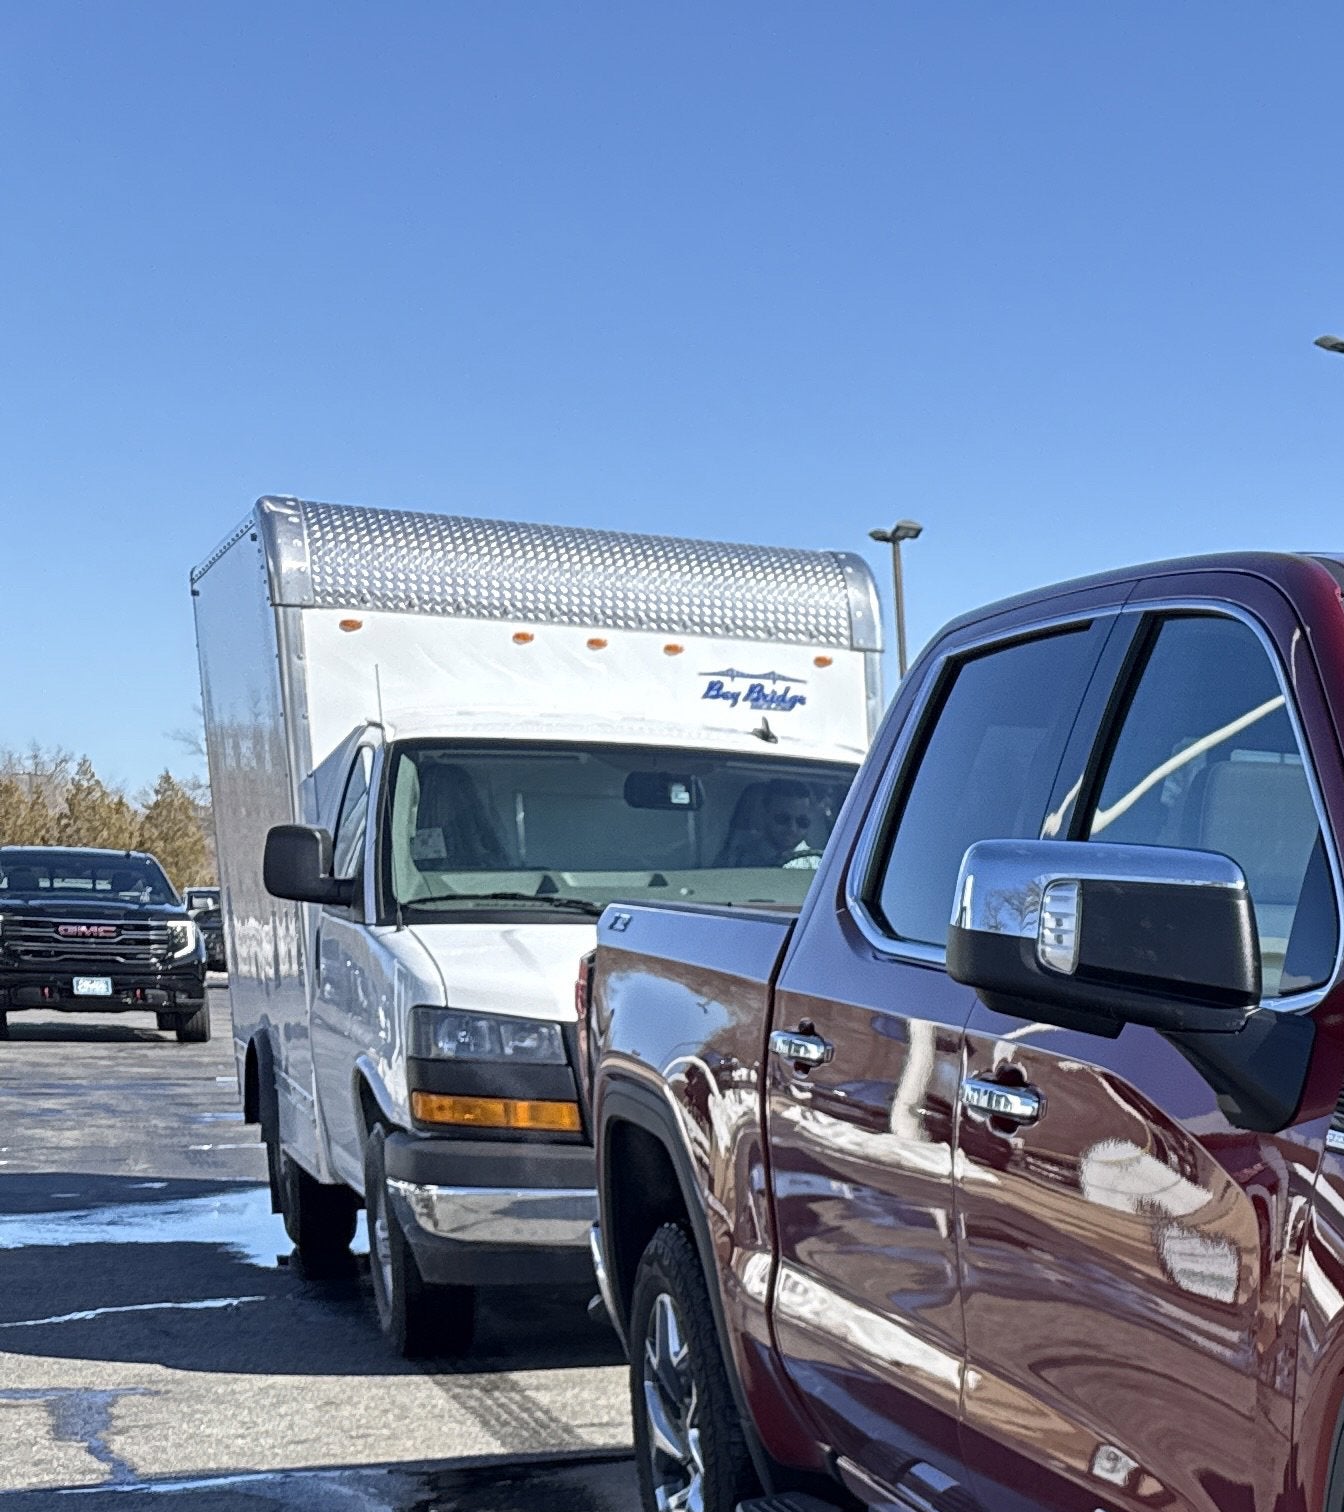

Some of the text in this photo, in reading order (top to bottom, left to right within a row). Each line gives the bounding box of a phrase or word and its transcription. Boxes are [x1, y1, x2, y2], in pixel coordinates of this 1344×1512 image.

[701, 680, 806, 711] Bay Bridge
[58, 925, 117, 937] GMC
